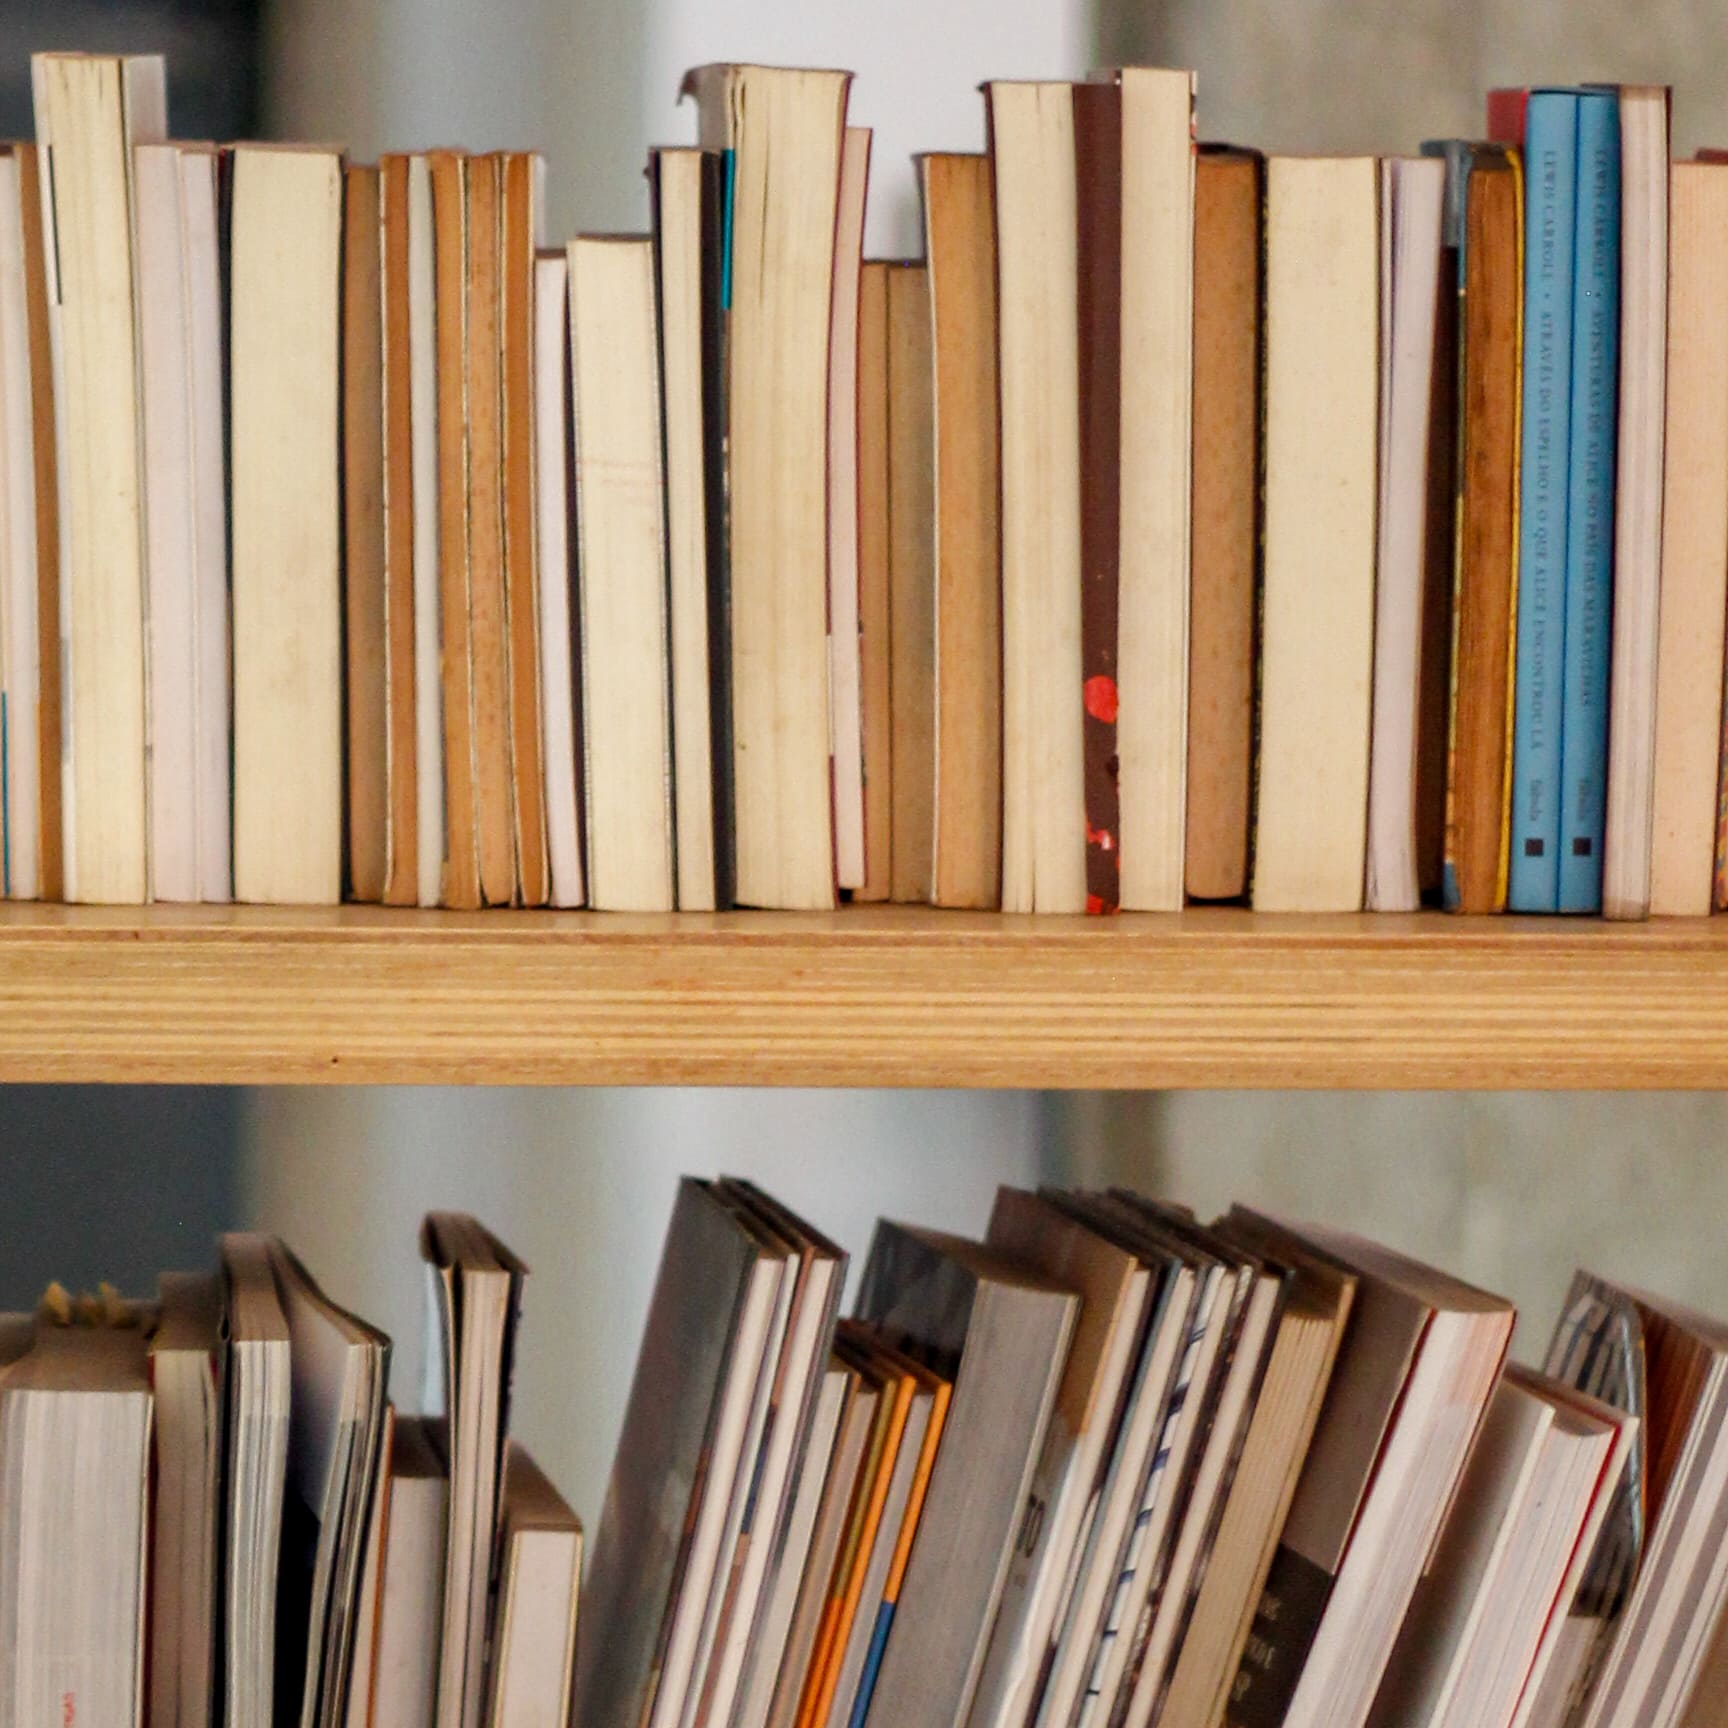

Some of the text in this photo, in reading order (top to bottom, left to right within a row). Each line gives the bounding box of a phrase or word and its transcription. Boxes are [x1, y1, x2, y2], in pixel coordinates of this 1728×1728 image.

[1543, 150, 1556, 199] LEWIS
[1542, 205, 1556, 282] CARROLL
[1539, 387, 1553, 411] DO
[1534, 527, 1548, 560] QUE
[1534, 565, 1548, 612] ALICE
